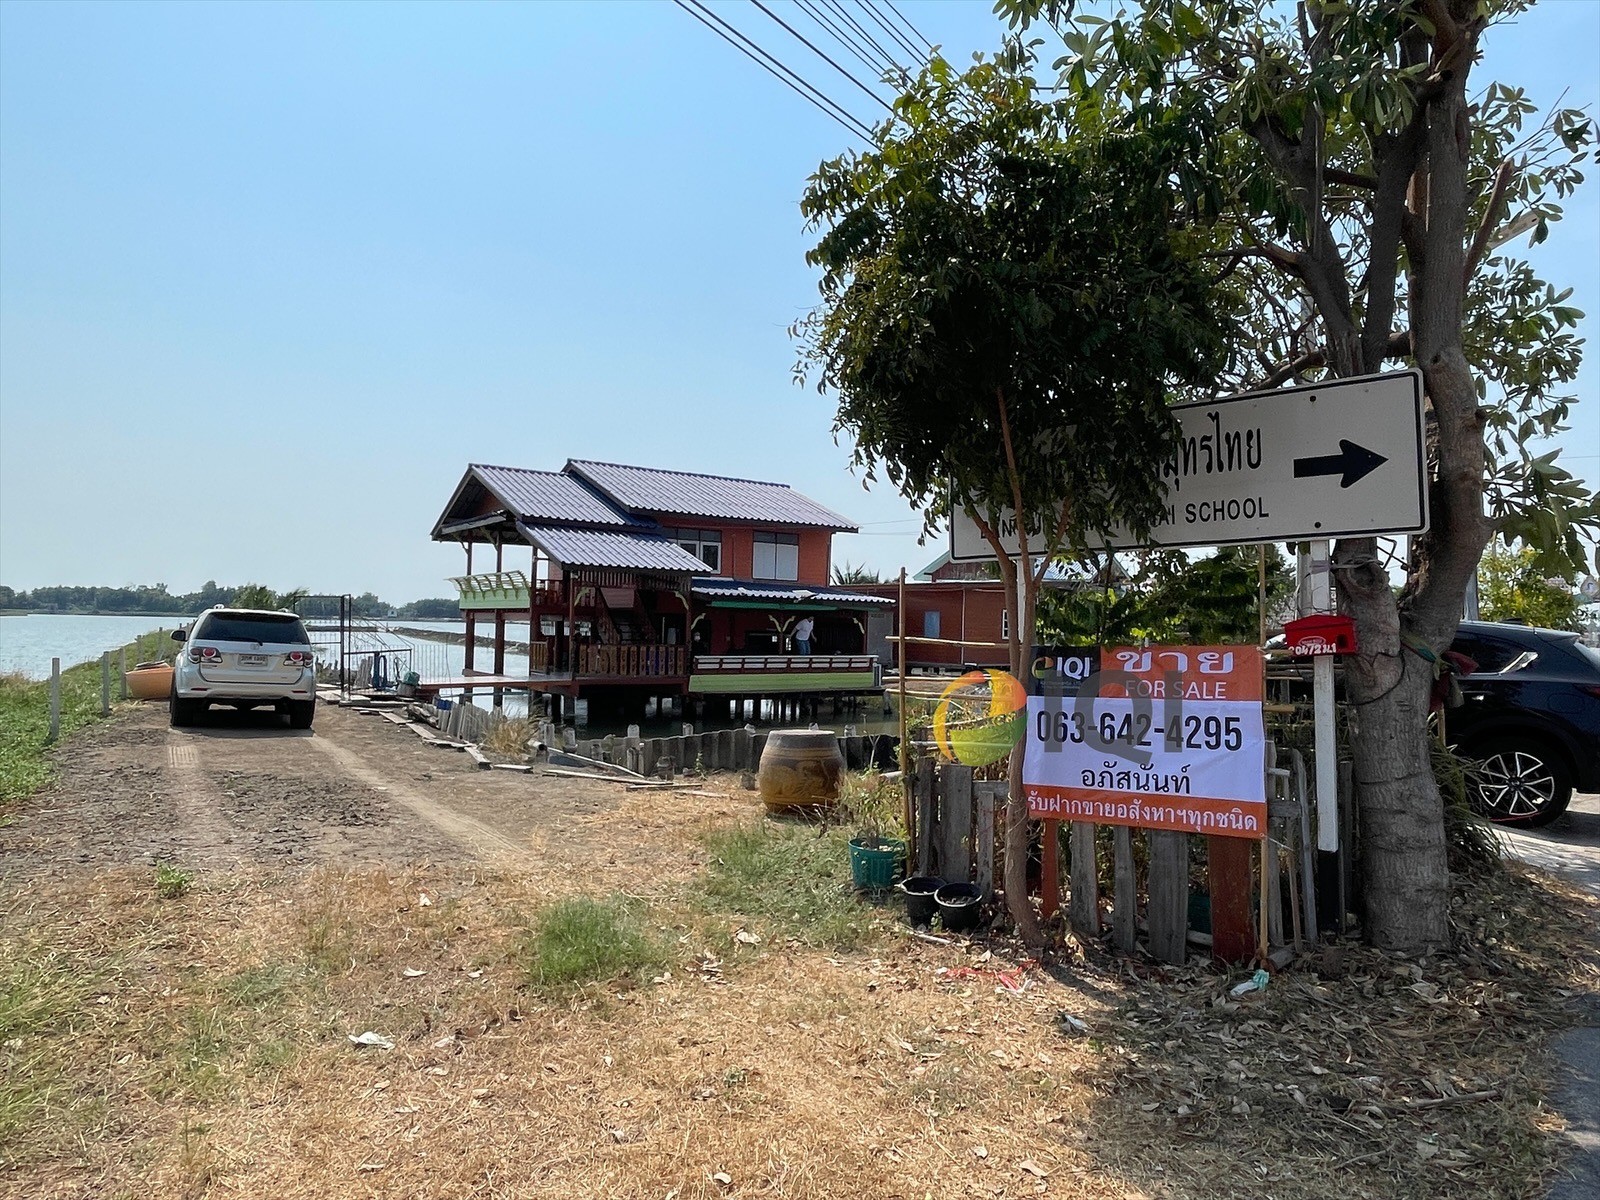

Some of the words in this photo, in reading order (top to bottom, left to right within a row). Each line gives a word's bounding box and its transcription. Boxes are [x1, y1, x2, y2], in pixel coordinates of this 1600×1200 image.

[1185, 496, 1270, 524] SCHOOL
[1056, 656, 1091, 680] IQI
[1116, 651, 1234, 674] ขาย
[1125, 680, 1166, 698] FOR
[1173, 681, 1227, 699] SALE
[1036, 710, 1243, 751] 063-642-4295
[1080, 761, 1192, 794] อภัสนันท์
